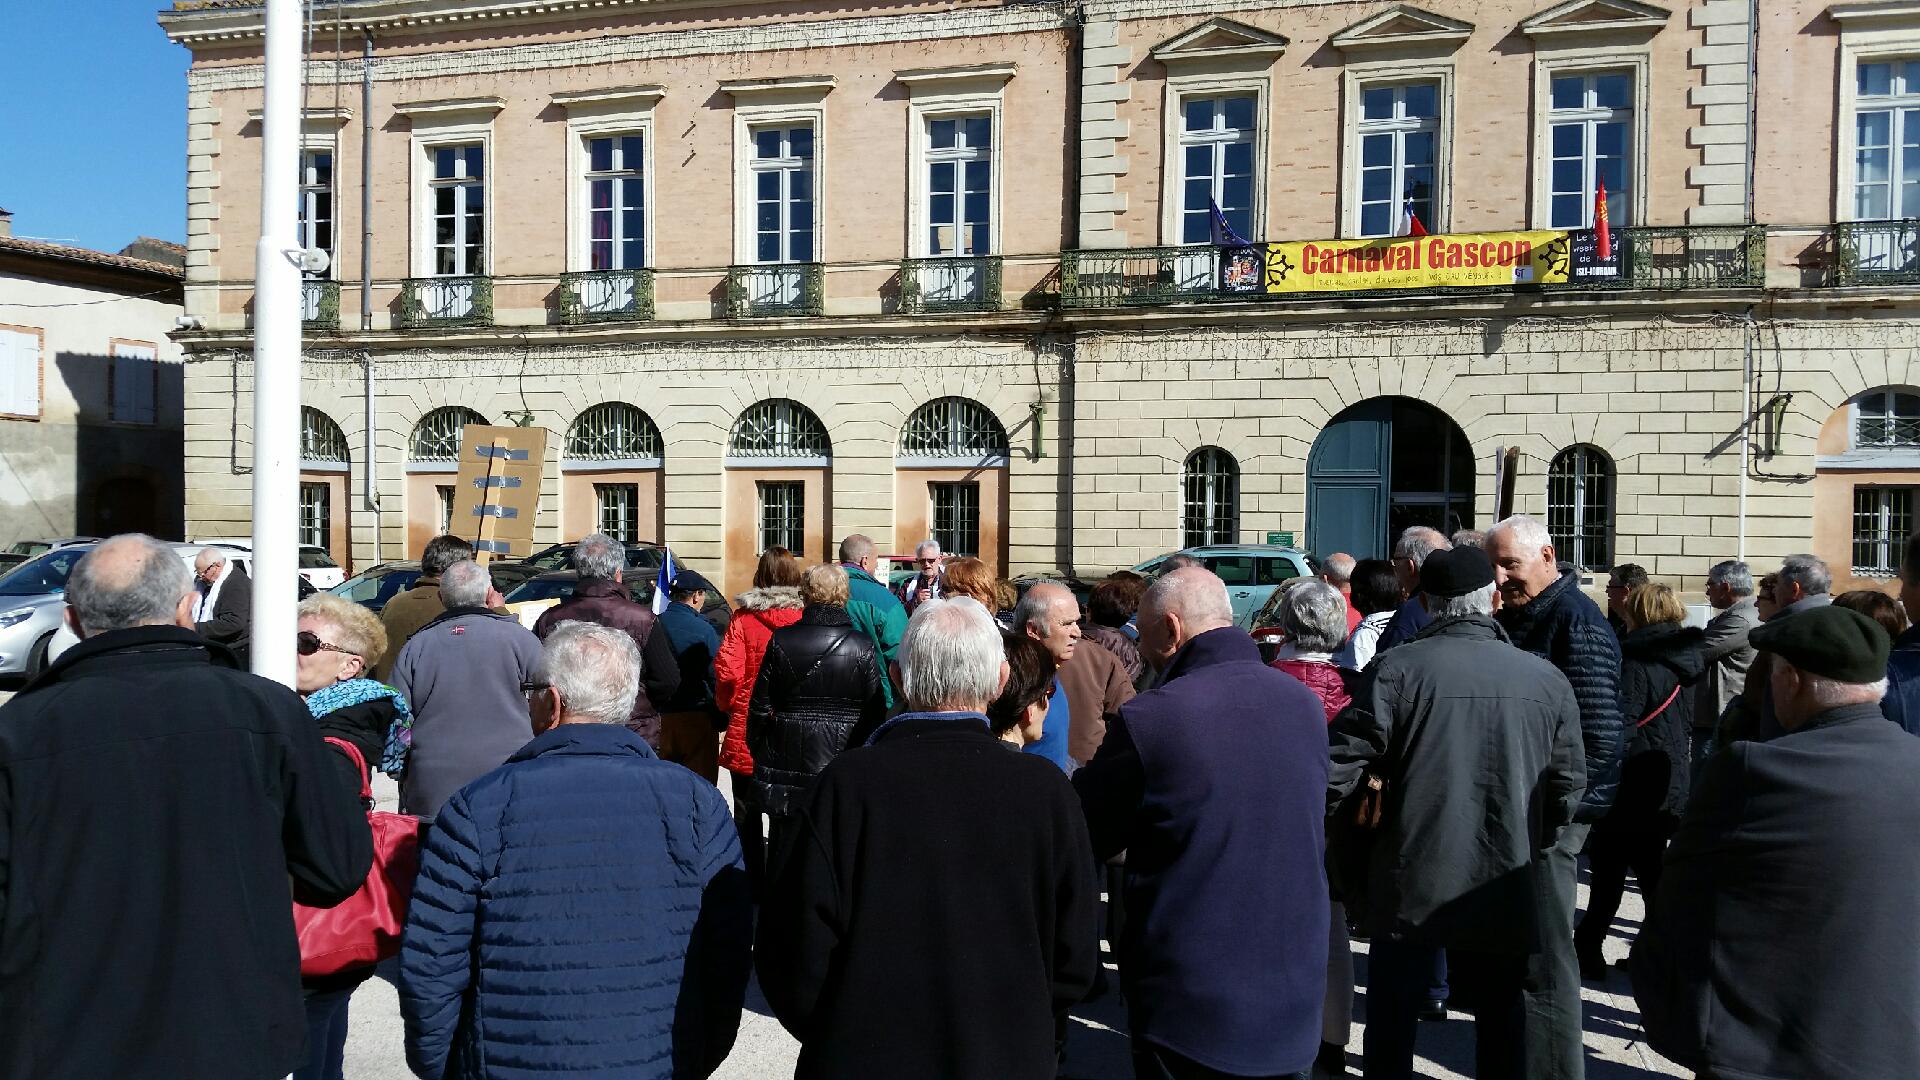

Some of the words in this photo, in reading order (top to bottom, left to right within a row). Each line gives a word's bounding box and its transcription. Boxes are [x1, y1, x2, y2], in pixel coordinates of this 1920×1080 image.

[1576, 233, 1588, 241] Le
[1302, 240, 1421, 275] Carnaval
[1428, 239, 1531, 270] Gascon
[1580, 253, 1591, 262] de
